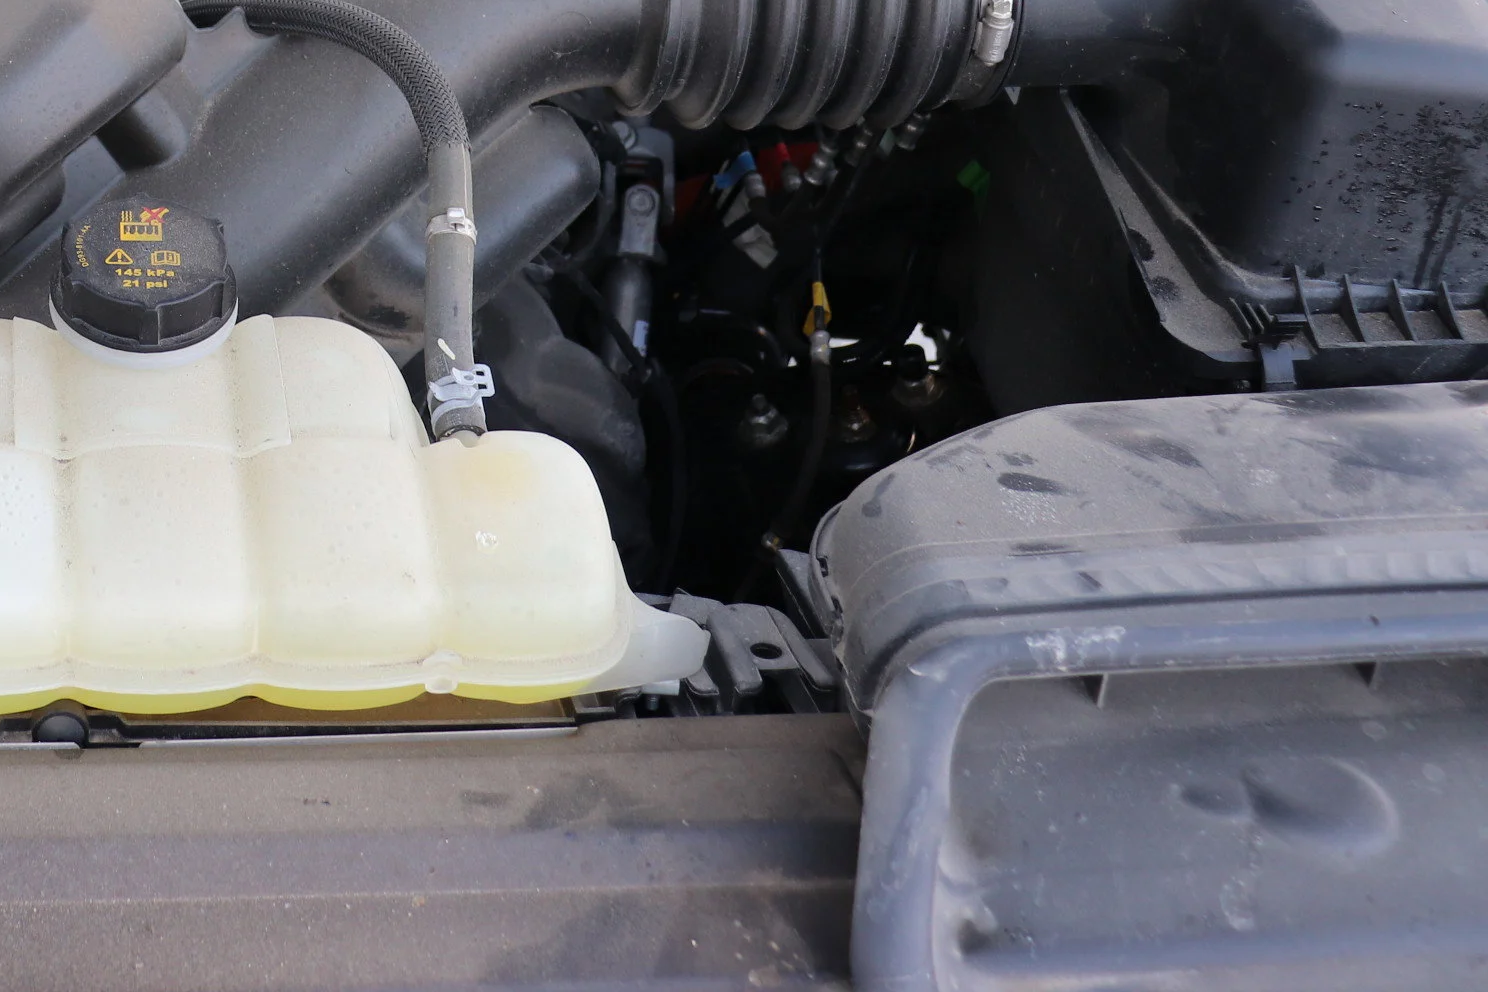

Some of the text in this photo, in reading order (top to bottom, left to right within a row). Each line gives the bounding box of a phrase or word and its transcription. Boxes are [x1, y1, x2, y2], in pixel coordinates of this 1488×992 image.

[115, 268, 176, 277] 145 kPa
[123, 279, 168, 289] 21 psi
